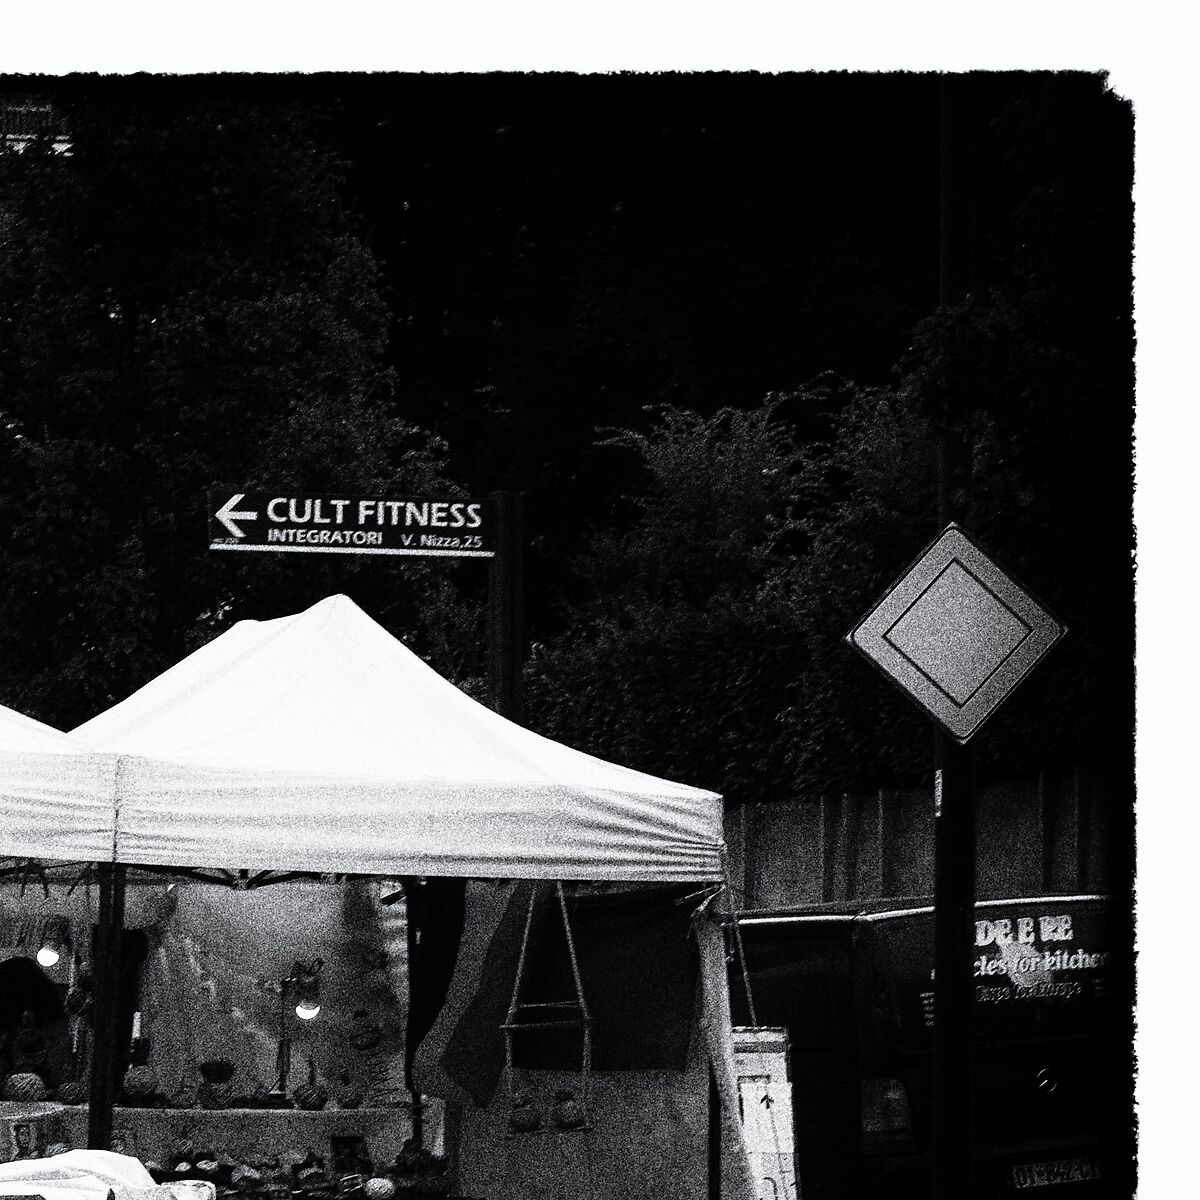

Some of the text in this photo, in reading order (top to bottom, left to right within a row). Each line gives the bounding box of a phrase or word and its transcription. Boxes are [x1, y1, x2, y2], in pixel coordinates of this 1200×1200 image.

[266, 497, 482, 528] CULT FITNESS
[267, 528, 382, 545] INTEGRATORI
[400, 533, 417, 547] V.
